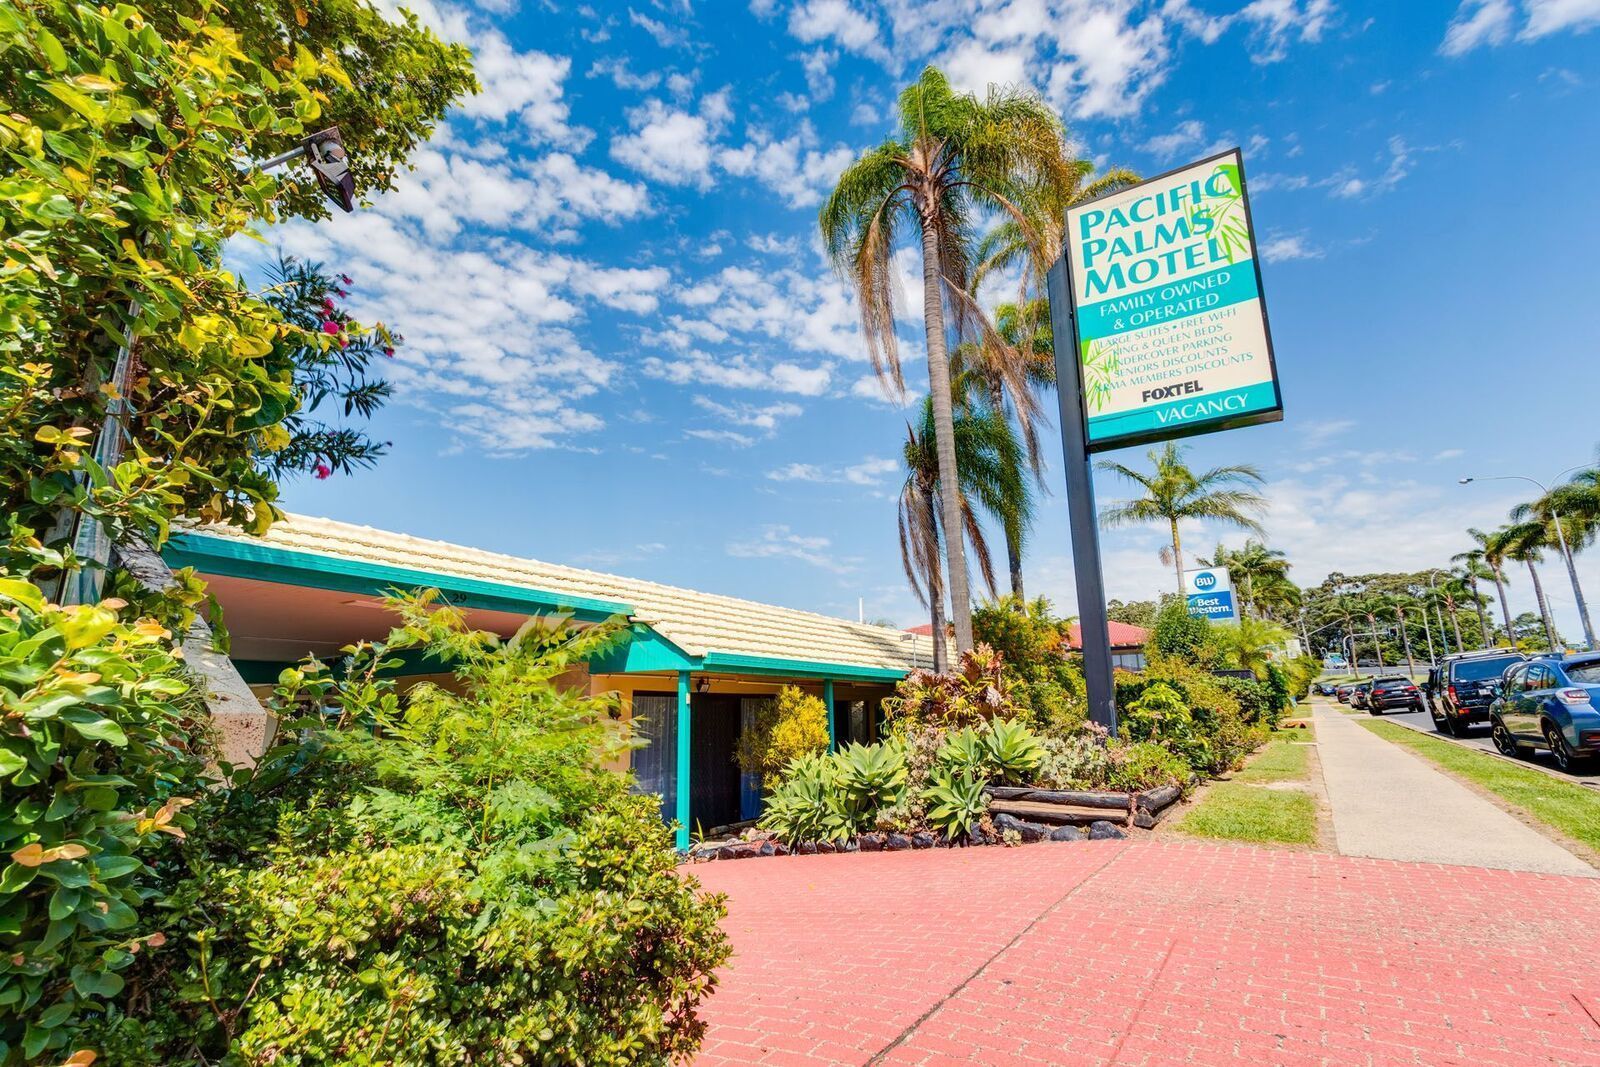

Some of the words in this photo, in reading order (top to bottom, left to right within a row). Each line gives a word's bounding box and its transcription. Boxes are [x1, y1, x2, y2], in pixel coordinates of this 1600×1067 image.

[1079, 170, 1232, 240] PACIFIC
[1082, 208, 1215, 268] PALMS
[1085, 237, 1229, 298] MOTEL
[1100, 292, 1156, 317] FAMILY
[1161, 271, 1231, 300] OWNED
[1100, 334, 1130, 348] LARGE
[1135, 326, 1169, 340] SUITES
[1181, 317, 1205, 329] FREE
[1208, 307, 1236, 322] WI-FI
[1113, 318, 1125, 330] &
[1130, 293, 1219, 325] OPERATED
[1113, 344, 1138, 355] KING
[1142, 342, 1149, 350] &
[1152, 333, 1191, 348] QUEEN
[1194, 323, 1223, 337] BEDS
[1182, 333, 1232, 351] PARKING
[1114, 362, 1159, 377] SENIORS
[1162, 346, 1228, 368] DISCOUNTS
[1130, 368, 1182, 386] MEMBERS
[1185, 352, 1253, 375] DISCOUNTS
[1142, 380, 1203, 403] FOXTEL
[1156, 393, 1249, 423] VACANCY
[452, 592, 467, 603] 29
[1196, 576, 1214, 587] BW
[1197, 597, 1220, 607] Best
